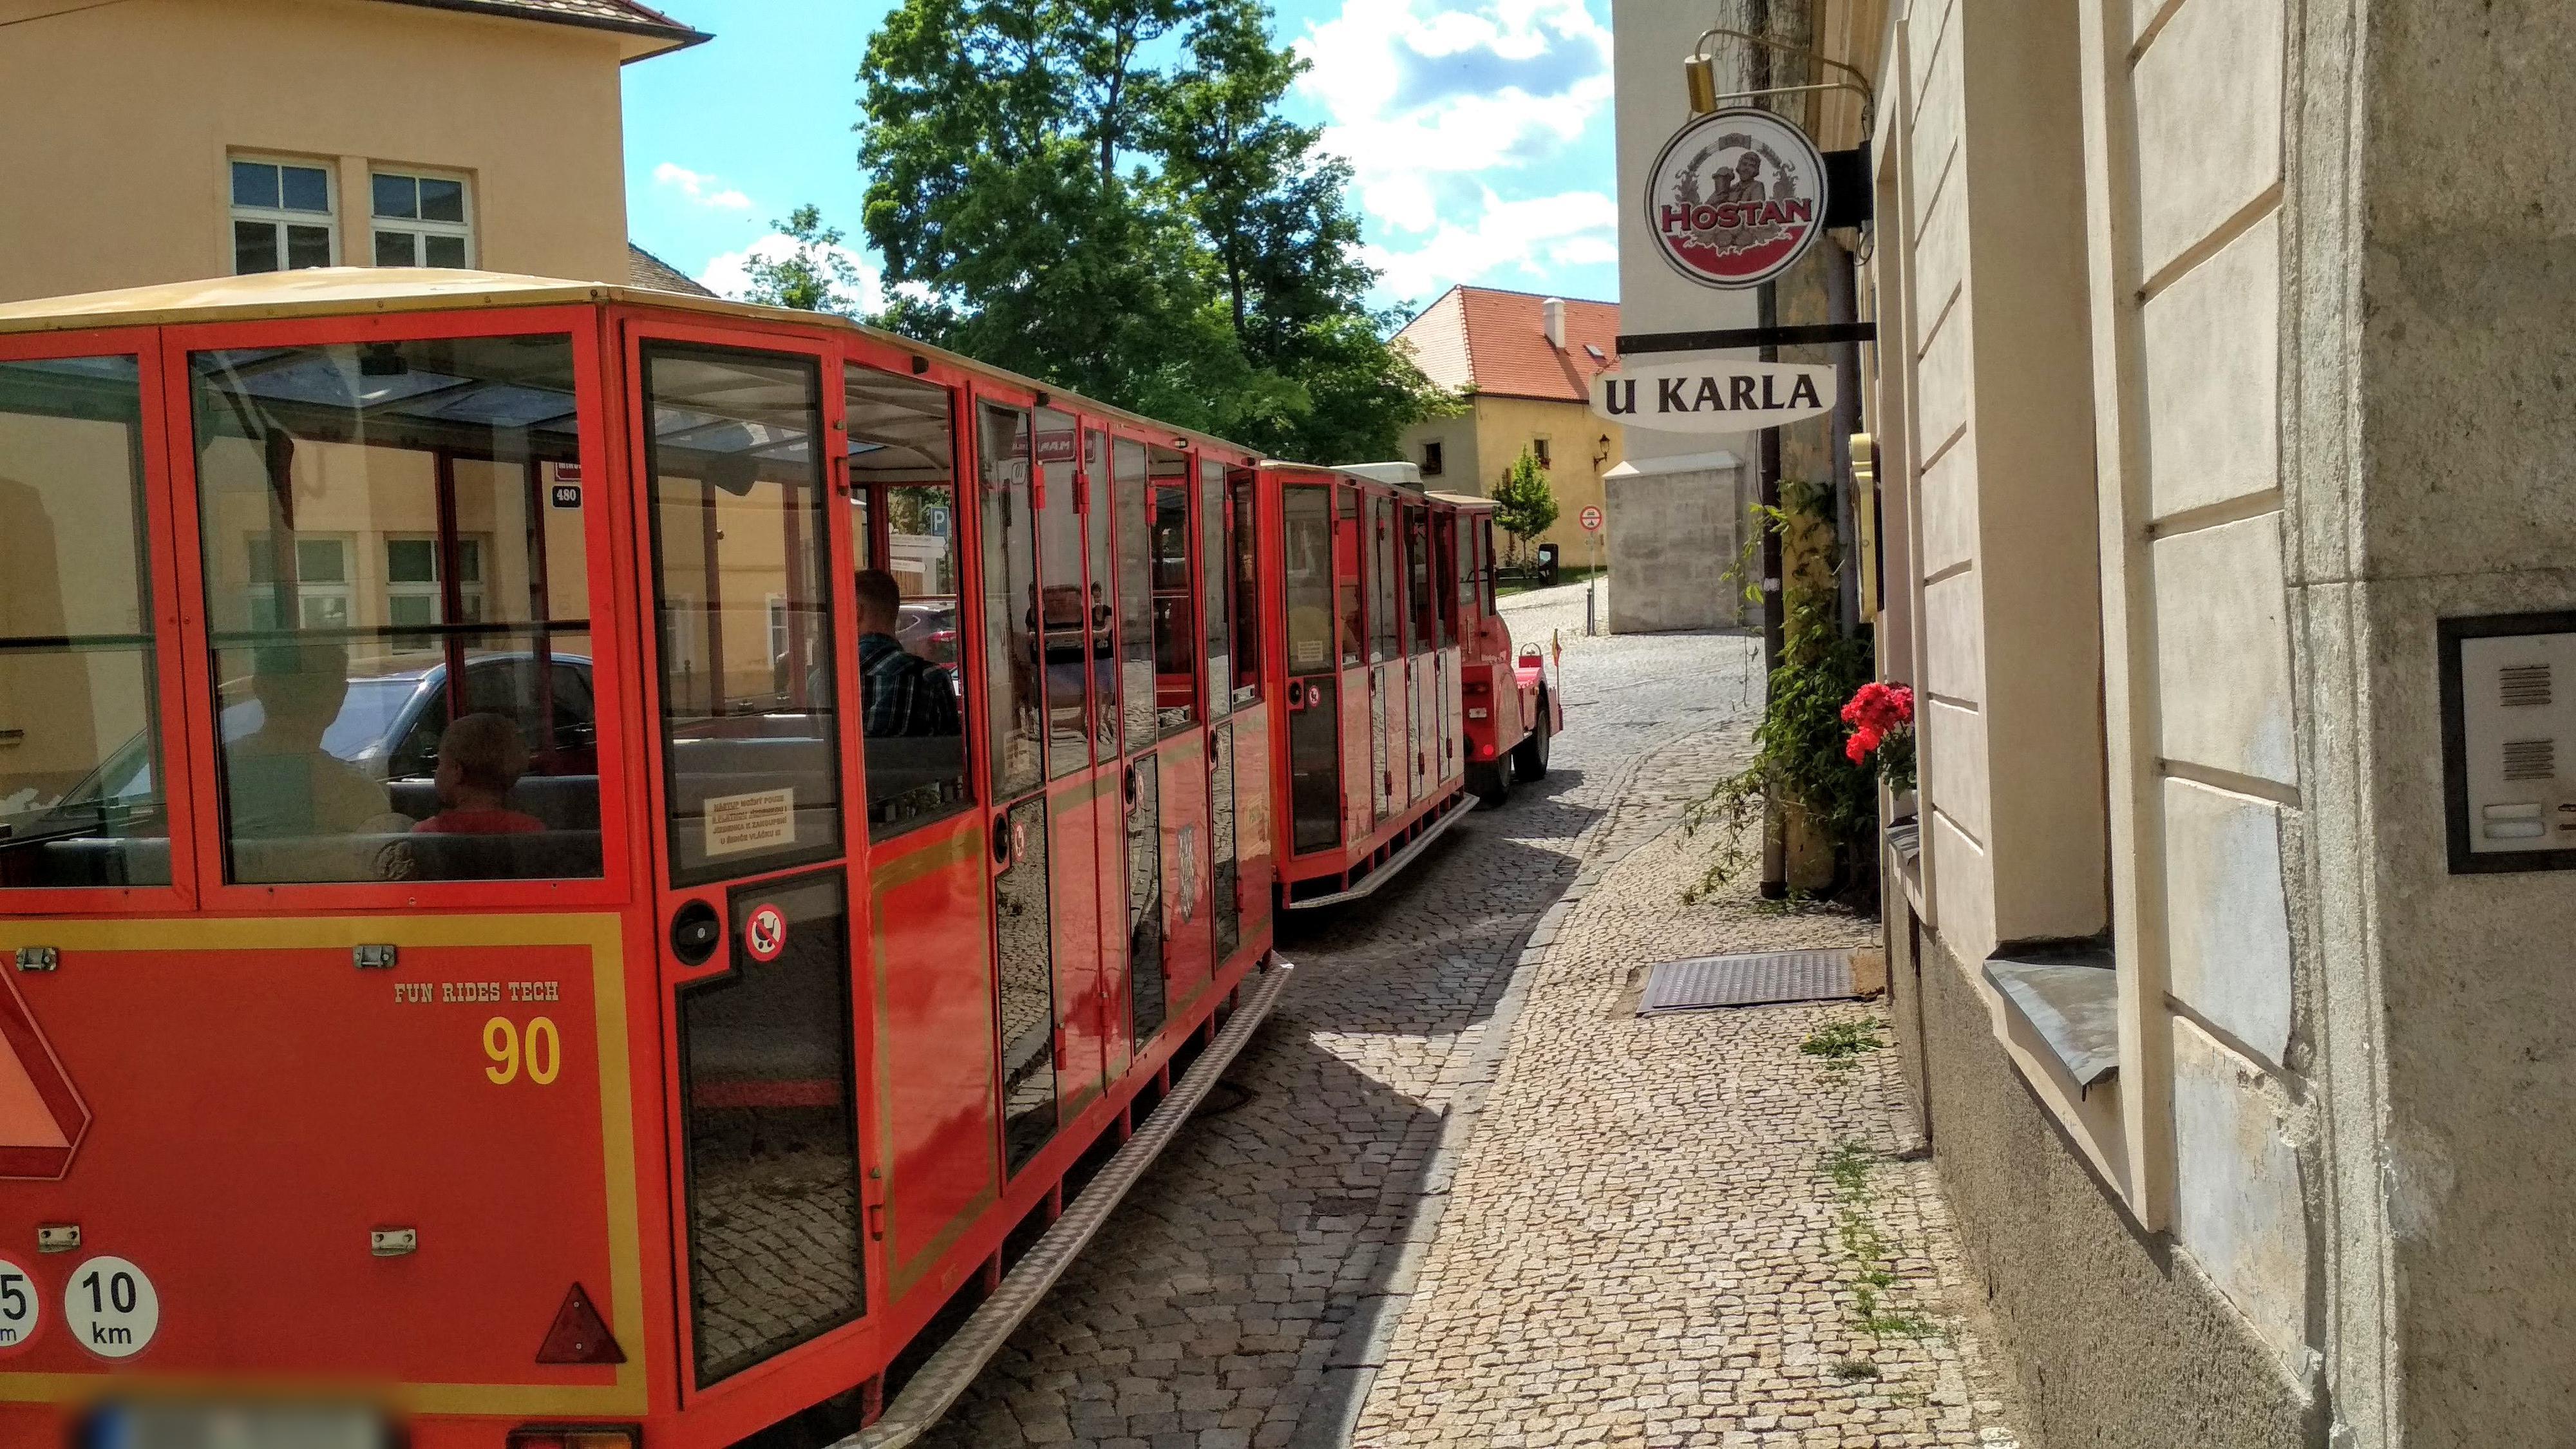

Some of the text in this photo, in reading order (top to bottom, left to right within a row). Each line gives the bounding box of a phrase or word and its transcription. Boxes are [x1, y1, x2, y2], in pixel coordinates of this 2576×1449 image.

[1661, 198, 1813, 233] HOSTAN
[1658, 374, 1823, 413] KARLA
[556, 489, 577, 501] 480
[934, 510, 945, 531] P
[394, 981, 559, 1003] FUN RIDES TECH
[483, 1016, 560, 1085] 90
[82, 1271, 137, 1314] 10
[92, 1321, 132, 1345] km
